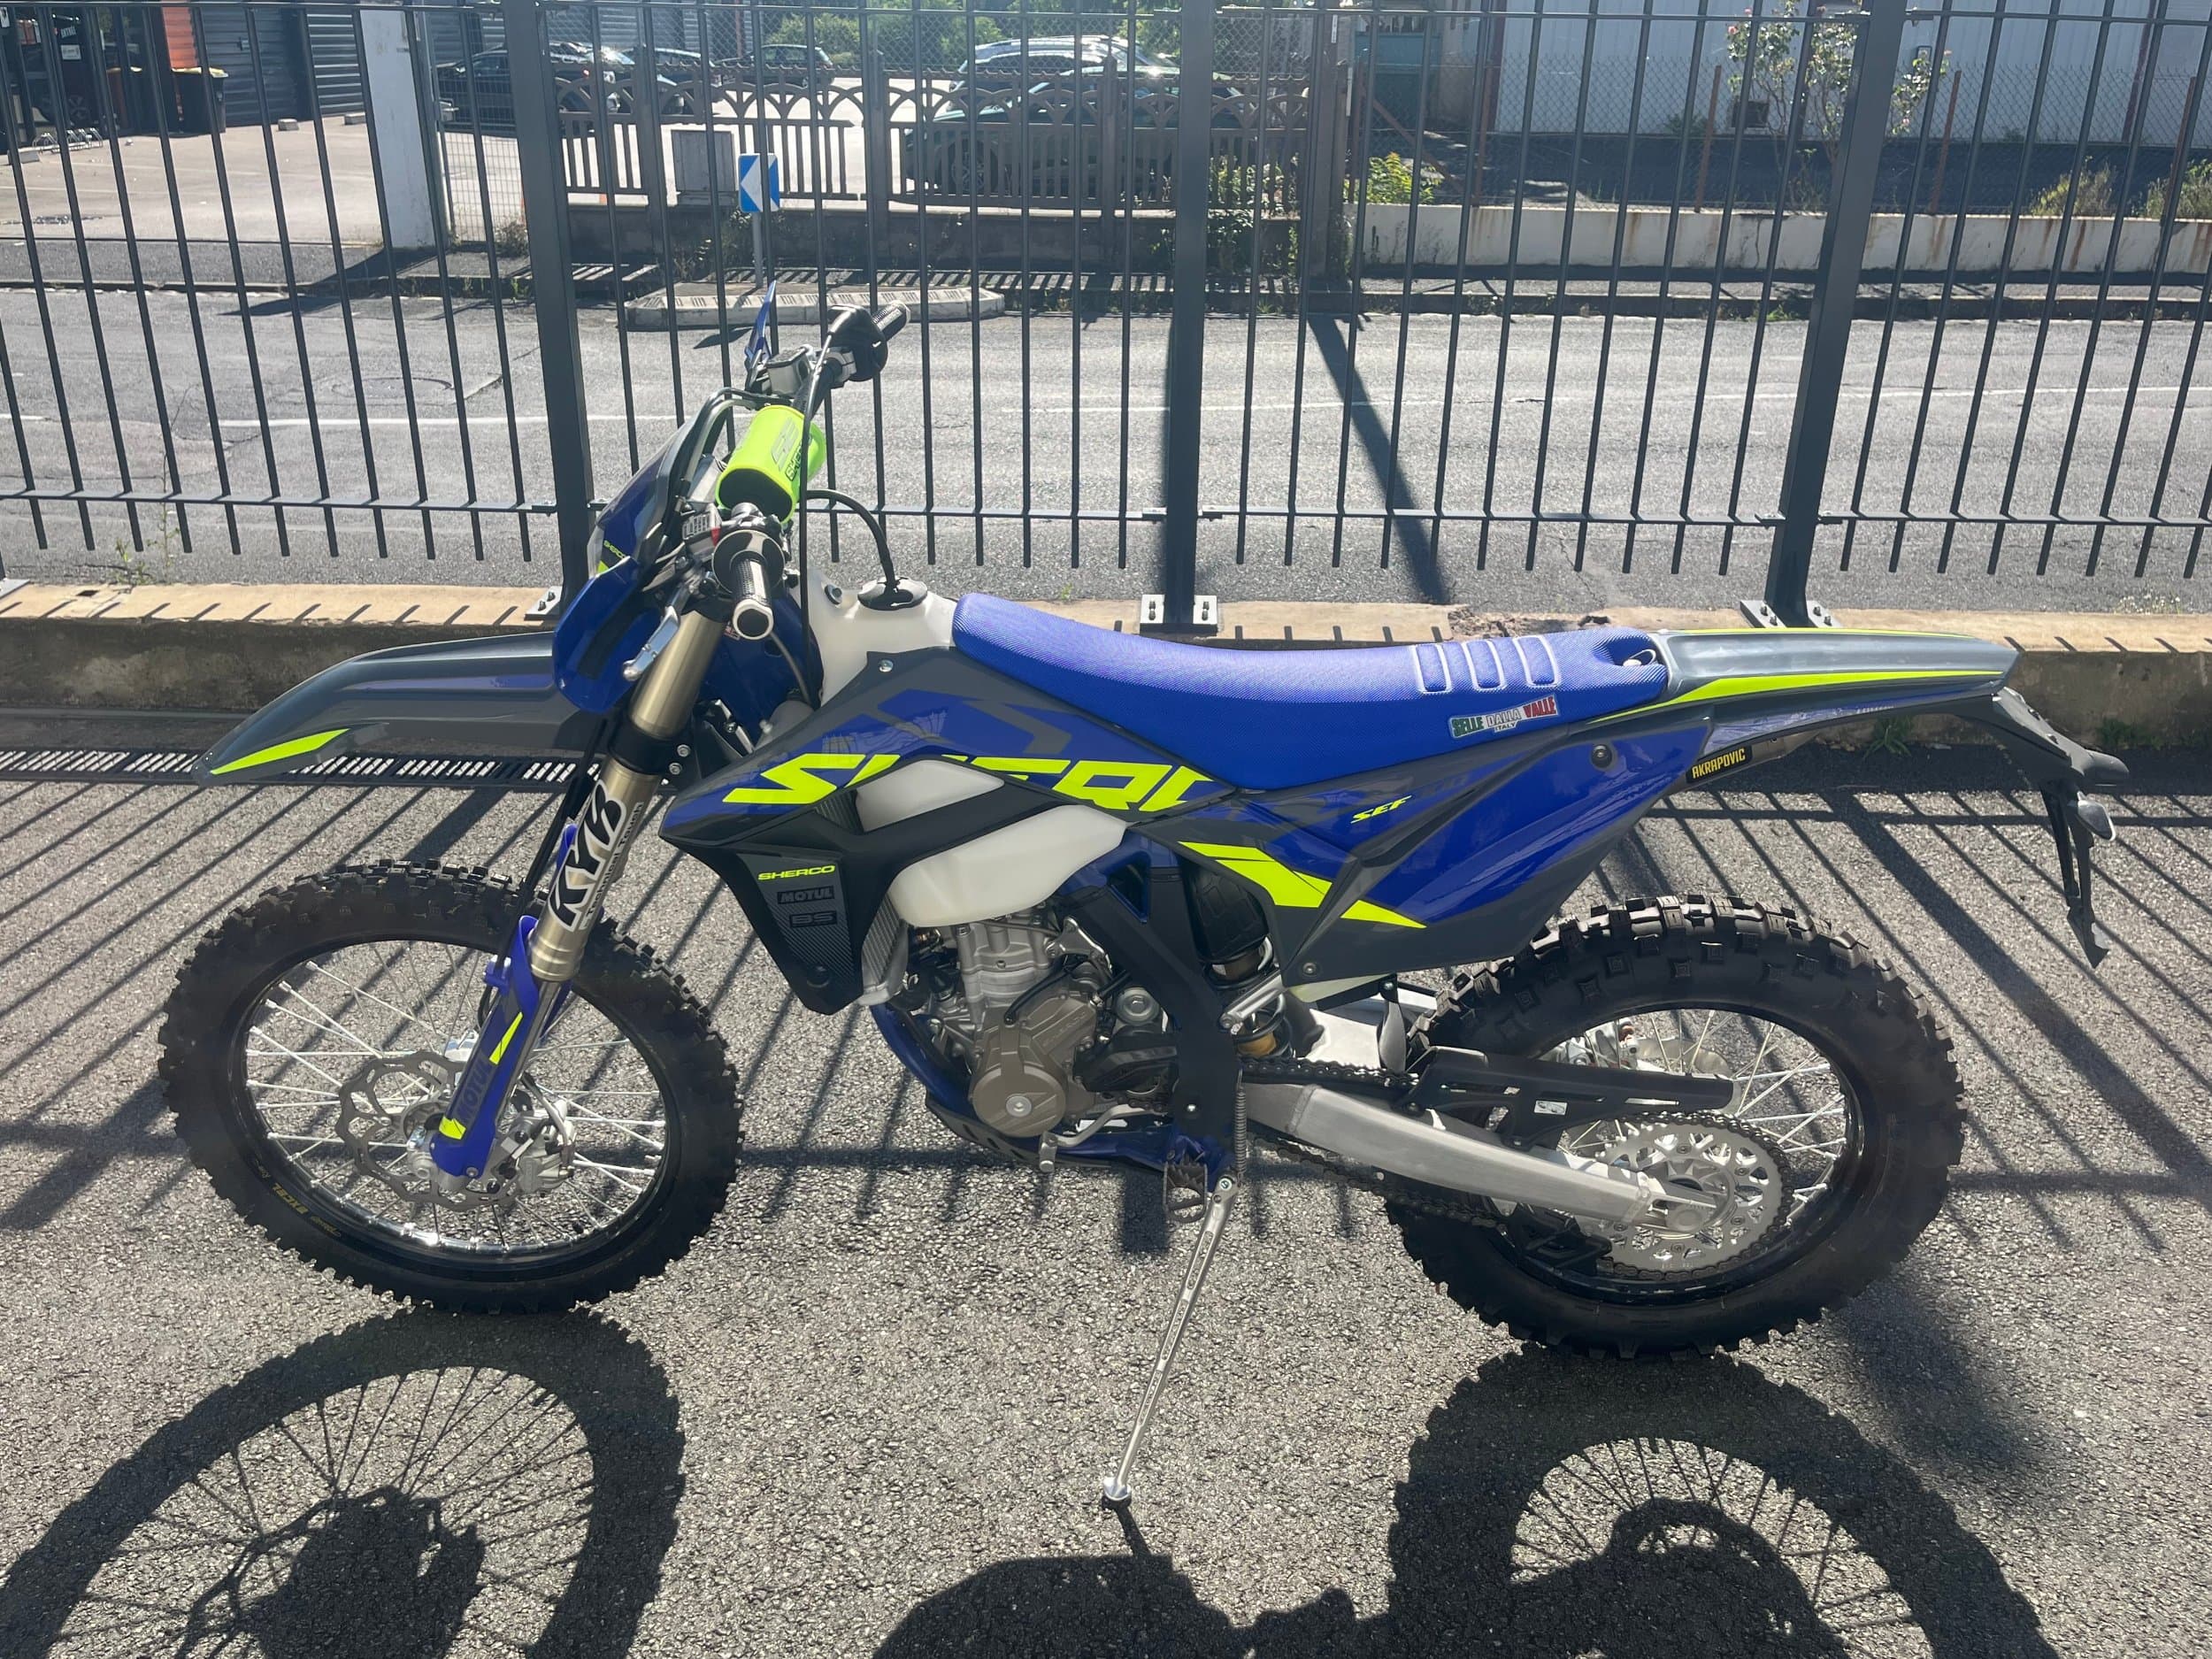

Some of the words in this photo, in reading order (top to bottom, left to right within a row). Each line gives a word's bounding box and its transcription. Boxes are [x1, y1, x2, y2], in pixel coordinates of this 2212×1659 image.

[1452, 717, 1484, 737] SELLE
[1486, 709, 1522, 727] DALLA
[1523, 696, 1556, 718] VALLE
[1495, 722, 1517, 732] ITALY
[1692, 749, 1746, 779] AKRAPOVIC
[1350, 795, 1413, 825] SEF
[549, 780, 627, 932] KYB
[586, 852, 621, 918] Technical
[618, 802, 645, 848] Touch
[757, 864, 836, 881] SHERCO
[780, 887, 833, 903] MOTUL
[454, 1058, 493, 1125] MOTUL
